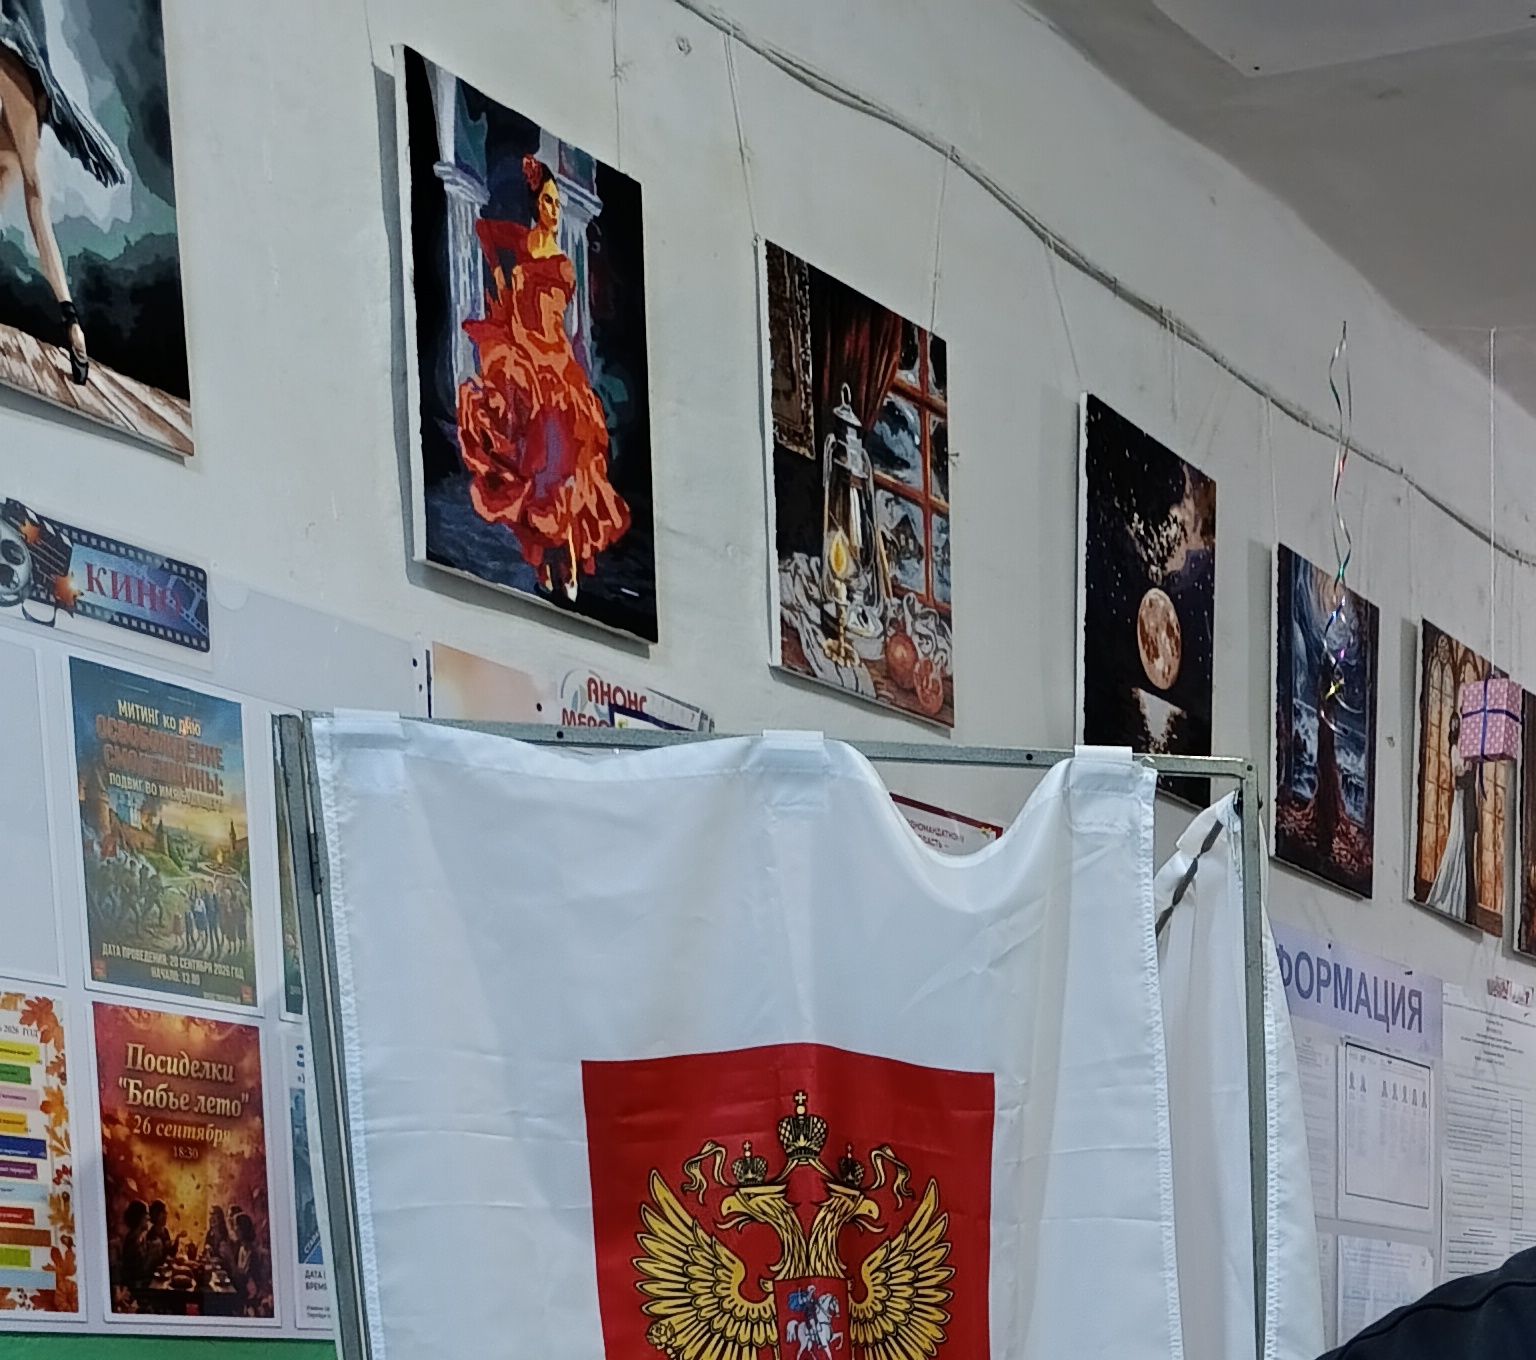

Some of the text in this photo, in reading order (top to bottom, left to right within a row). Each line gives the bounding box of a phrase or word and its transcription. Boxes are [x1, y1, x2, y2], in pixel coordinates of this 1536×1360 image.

[85, 562, 184, 619] КИНО
[117, 699, 160, 726] МИТИНГ
[109, 772, 144, 793] ПОДВИГ
[145, 781, 158, 795] ВО
[159, 784, 179, 801] ИМЯ
[102, 942, 122, 957] ДАТА
[170, 955, 179, 968] 20
[180, 956, 213, 973] СЕНТЯБРЯ
[213, 963, 230, 977] 2026
[22, 1027, 38, 1038] ГОД
[126, 1042, 235, 1083] Посиделки
[118, 1076, 249, 1117] "Бабье лето"
[132, 1114, 232, 1148] 26 сентября
[173, 1145, 199, 1160] 18:30
[304, 1269, 323, 1280] ДАТА
